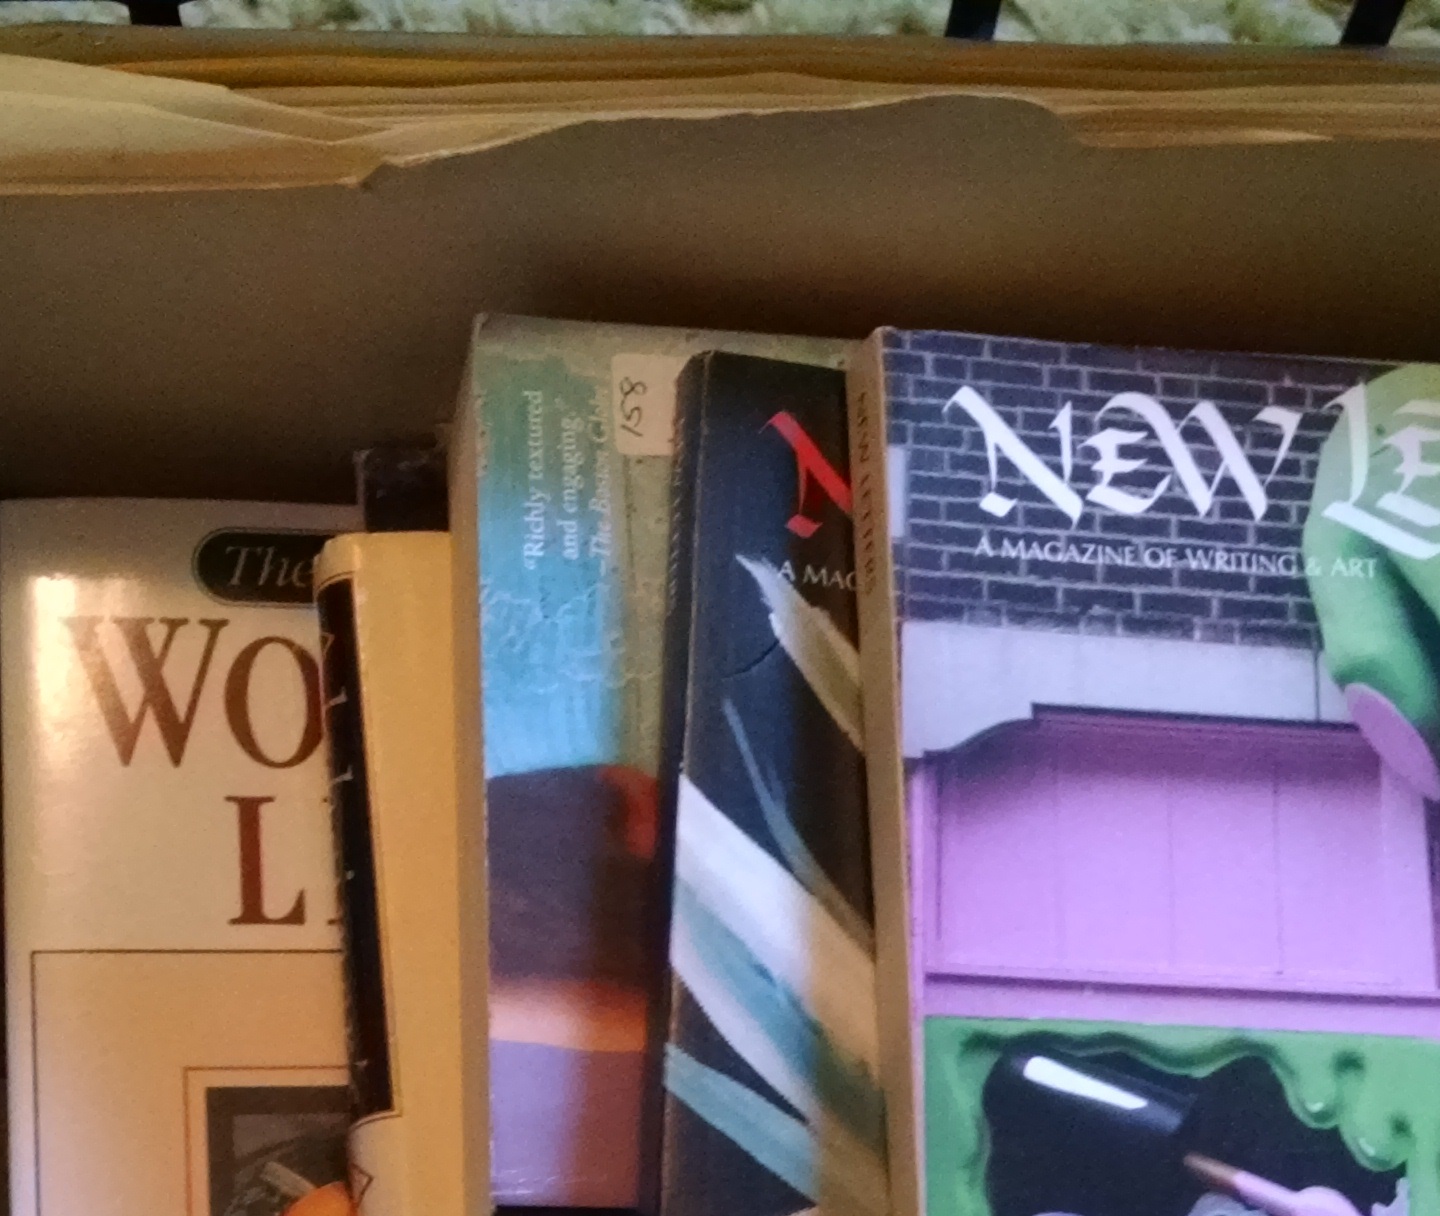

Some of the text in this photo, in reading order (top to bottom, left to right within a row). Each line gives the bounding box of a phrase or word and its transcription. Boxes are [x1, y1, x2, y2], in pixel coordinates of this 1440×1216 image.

[522, 389, 544, 480] textured
[943, 384, 1297, 529] NEW
[588, 450, 610, 515] Boston
[557, 519, 578, 561] and
[974, 536, 995, 558] A
[997, 537, 1138, 567] MAGAZINE
[1144, 548, 1176, 569] OF
[1185, 548, 1298, 576] WRITING
[1332, 557, 1380, 580] ART
[778, 558, 798, 583] A
